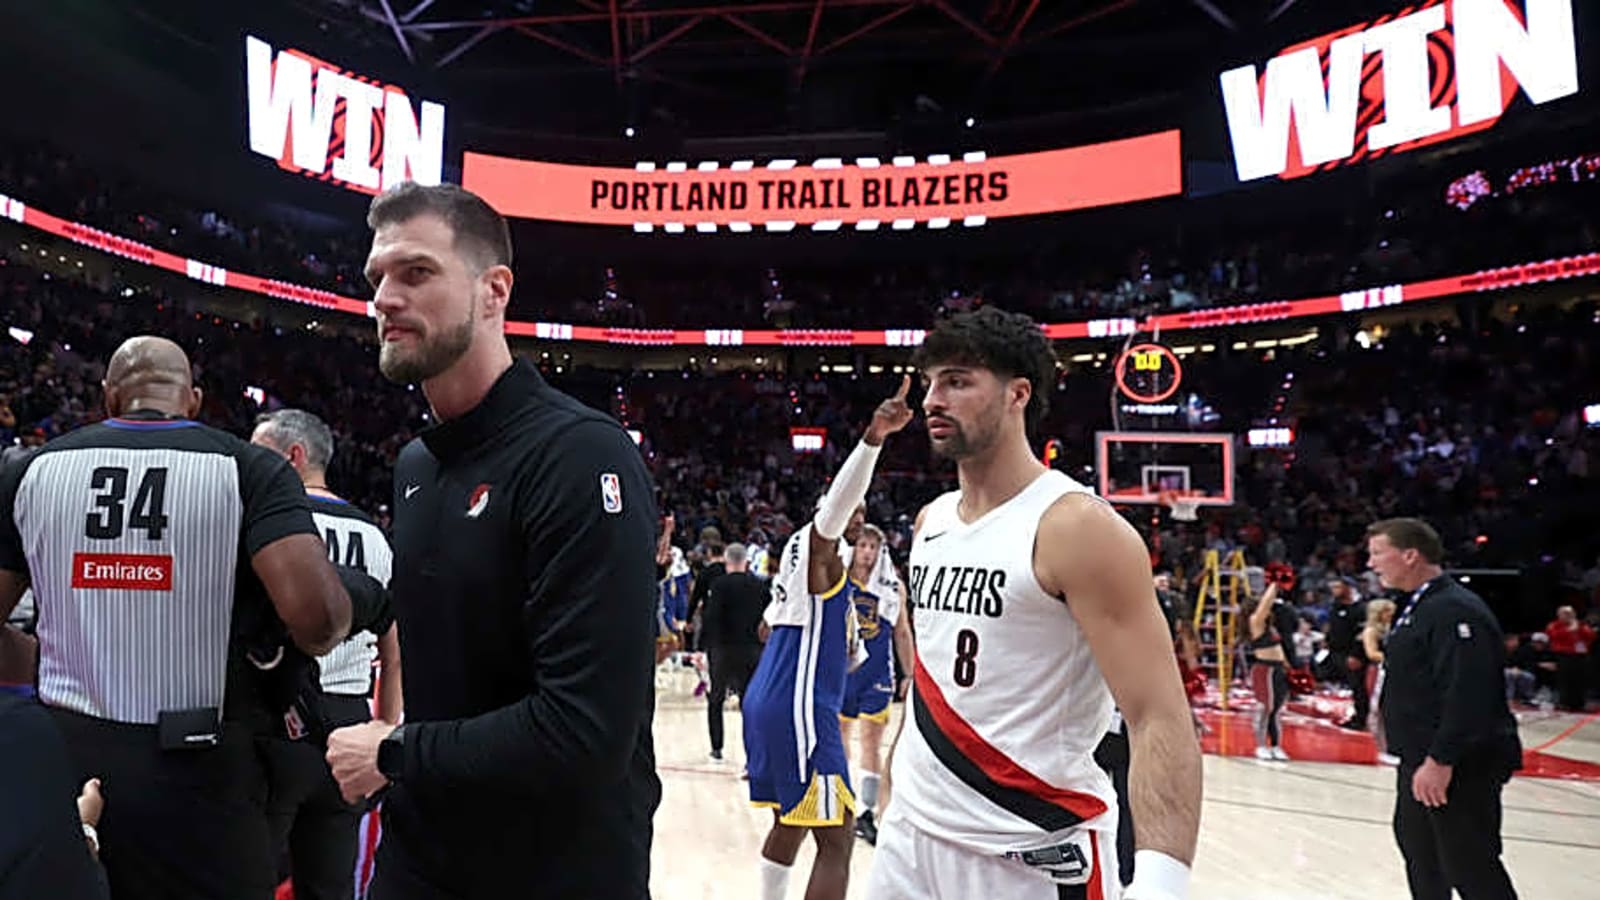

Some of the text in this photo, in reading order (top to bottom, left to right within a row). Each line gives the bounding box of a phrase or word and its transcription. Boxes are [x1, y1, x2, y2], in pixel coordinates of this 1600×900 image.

[1220, 0, 1579, 182] WIN
[246, 35, 445, 190] WIN
[591, 171, 1009, 211] PORTLAND TRAIL BLAZERS
[186, 258, 227, 287] WIN
[1340, 284, 1403, 312] WIN
[536, 322, 573, 340] WIN
[705, 329, 743, 346] WIN
[885, 329, 926, 346] WIN
[1087, 318, 1136, 337] WIN
[1248, 428, 1290, 445] WIN
[86, 467, 168, 540] 34
[83, 561, 164, 581] Emirates
[911, 565, 1007, 618] BLAZERS
[953, 628, 980, 688] 8
